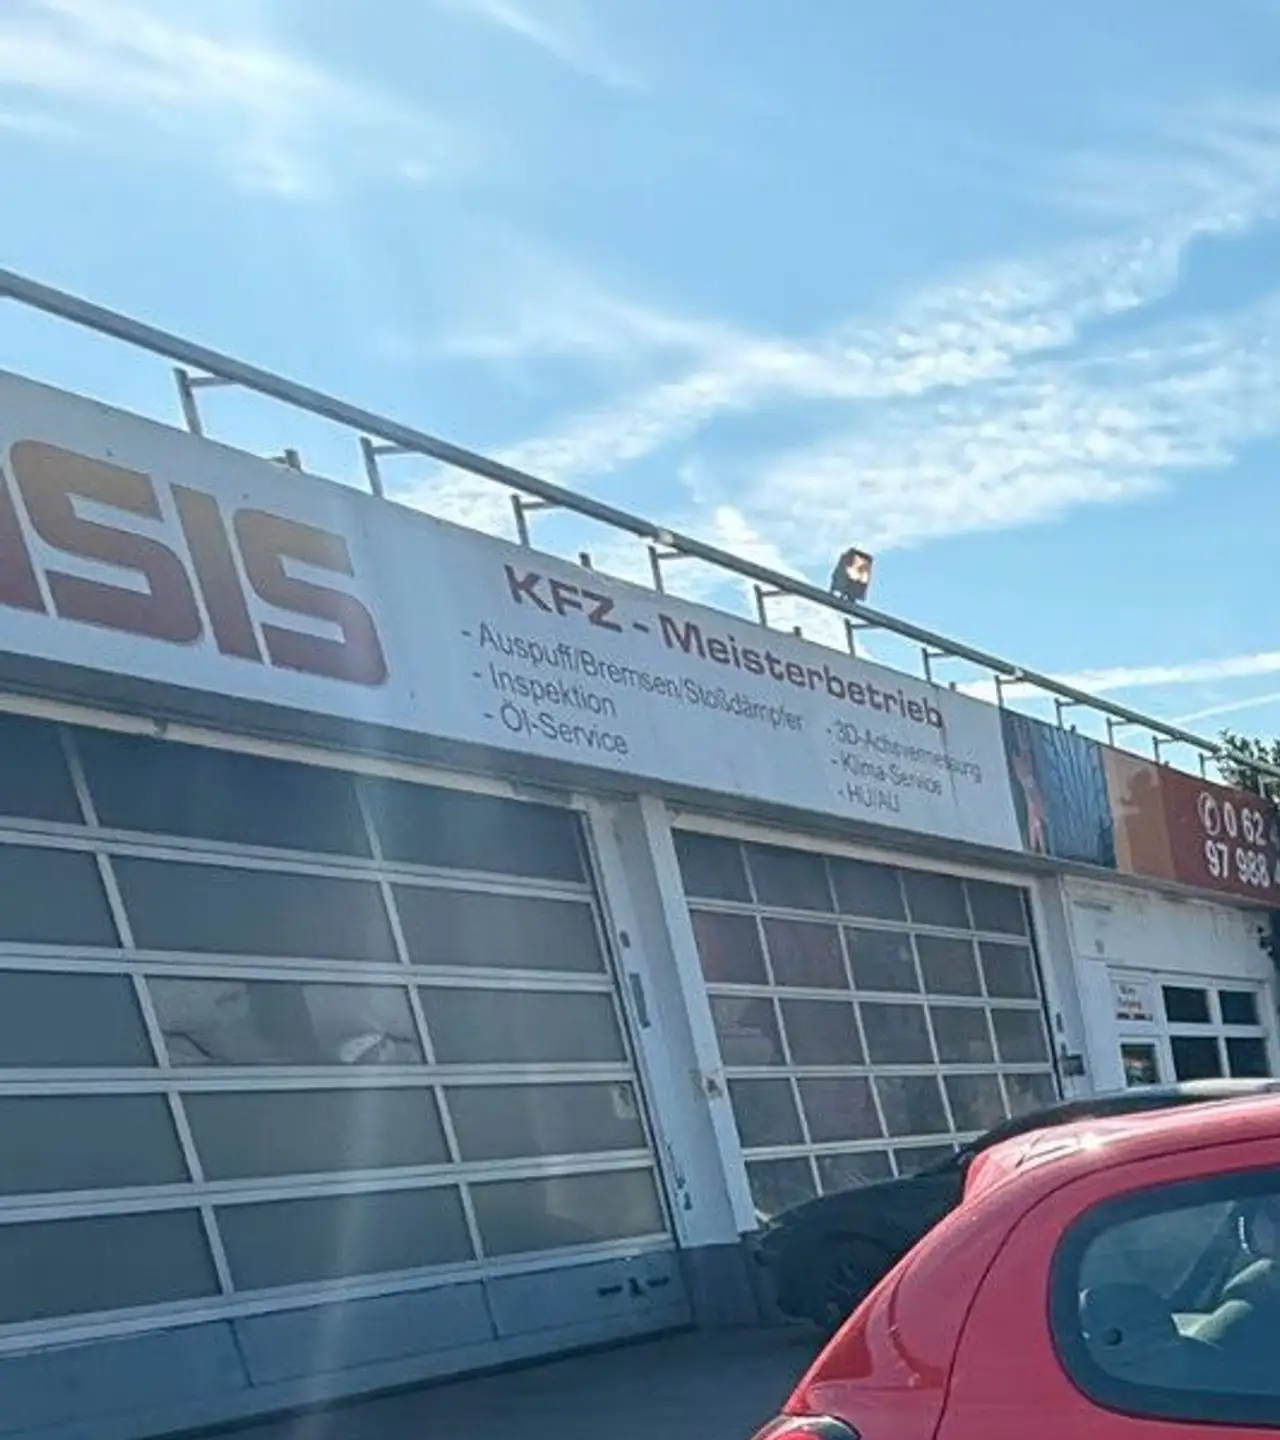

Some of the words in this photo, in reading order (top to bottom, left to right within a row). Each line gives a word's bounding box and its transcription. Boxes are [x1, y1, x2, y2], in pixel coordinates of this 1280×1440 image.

[488, 662, 618, 718] Inspektion
[499, 698, 629, 755] Öl-Service
[1205, 839, 1229, 879] 97
